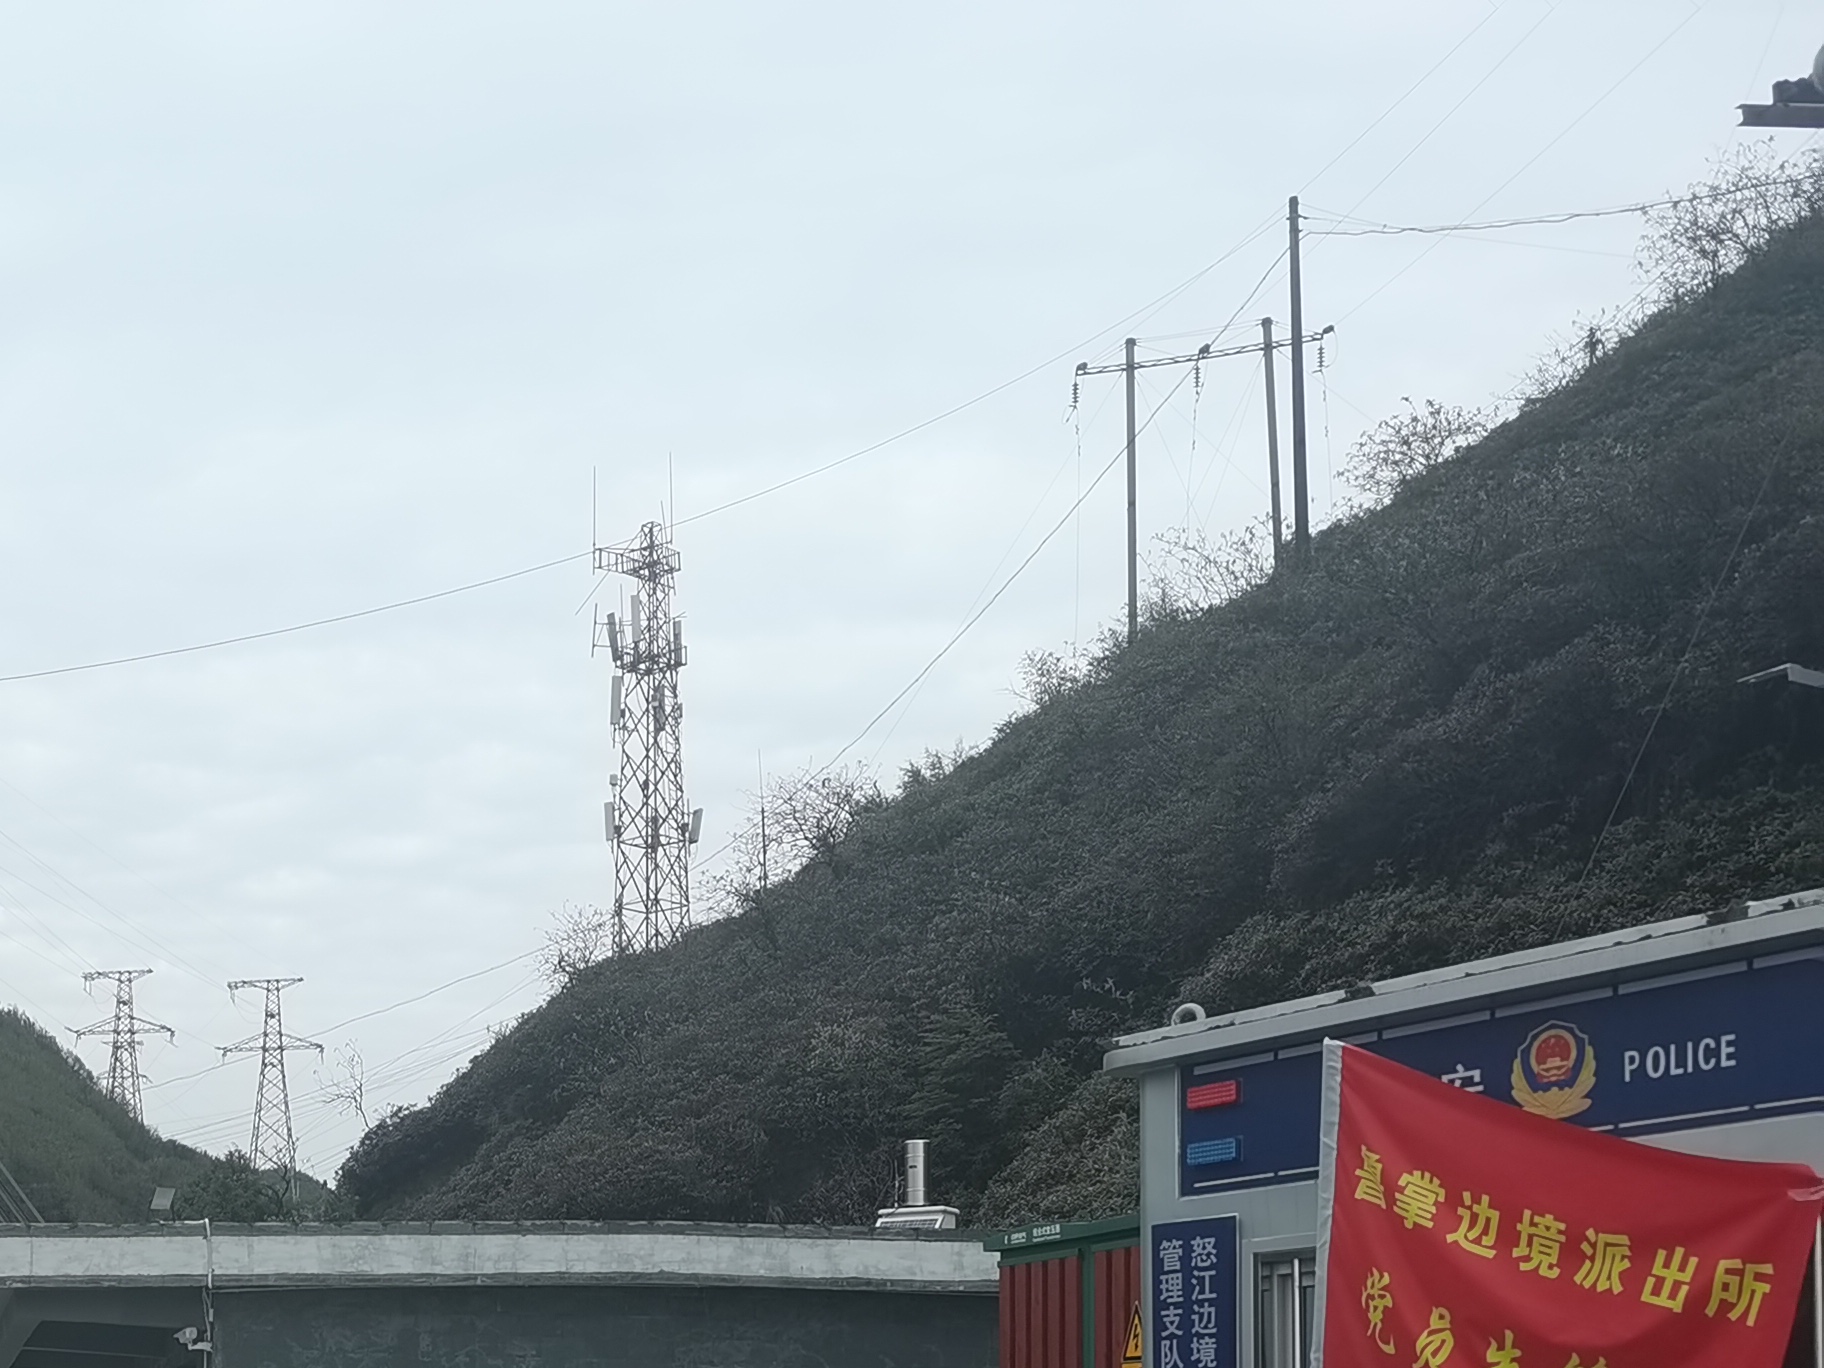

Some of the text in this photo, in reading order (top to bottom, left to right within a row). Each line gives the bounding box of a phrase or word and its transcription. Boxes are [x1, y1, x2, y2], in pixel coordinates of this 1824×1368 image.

[1623, 1033, 1737, 1083] POLICE
[1190, 1235, 1218, 1368] 怒江边境
